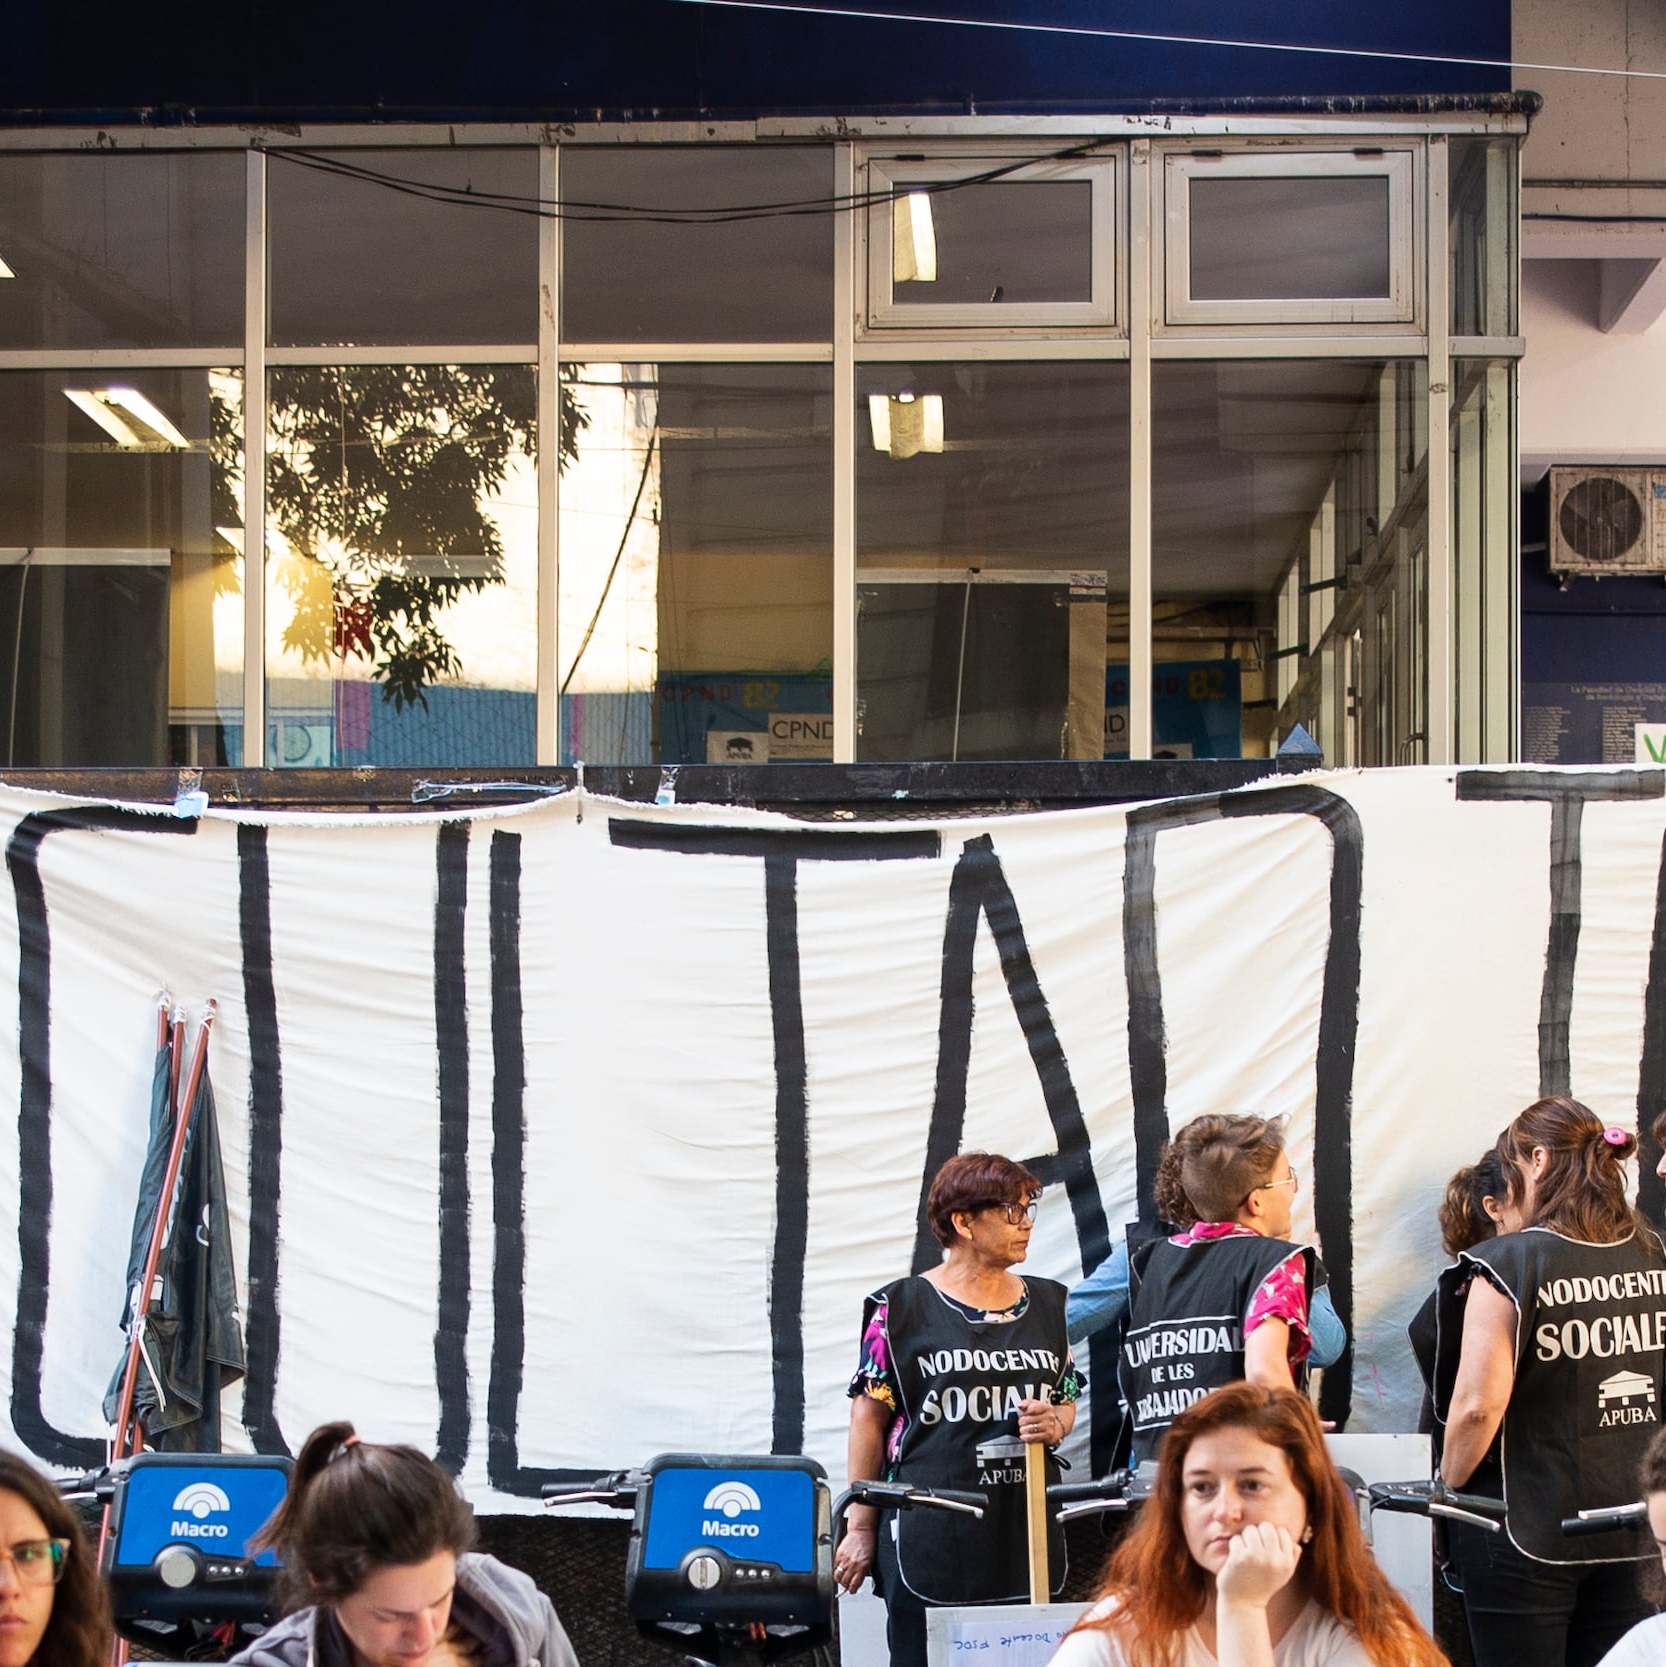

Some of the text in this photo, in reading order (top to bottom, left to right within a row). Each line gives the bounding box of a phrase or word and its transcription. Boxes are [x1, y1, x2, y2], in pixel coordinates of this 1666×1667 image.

[744, 680, 780, 709] 82
[771, 720, 834, 740] CPND
[1167, 1362, 1195, 1381] LES
[1598, 1405, 1658, 1428] APUBA
[170, 1520, 229, 1538] Macro
[701, 1519, 760, 1538] Macro
